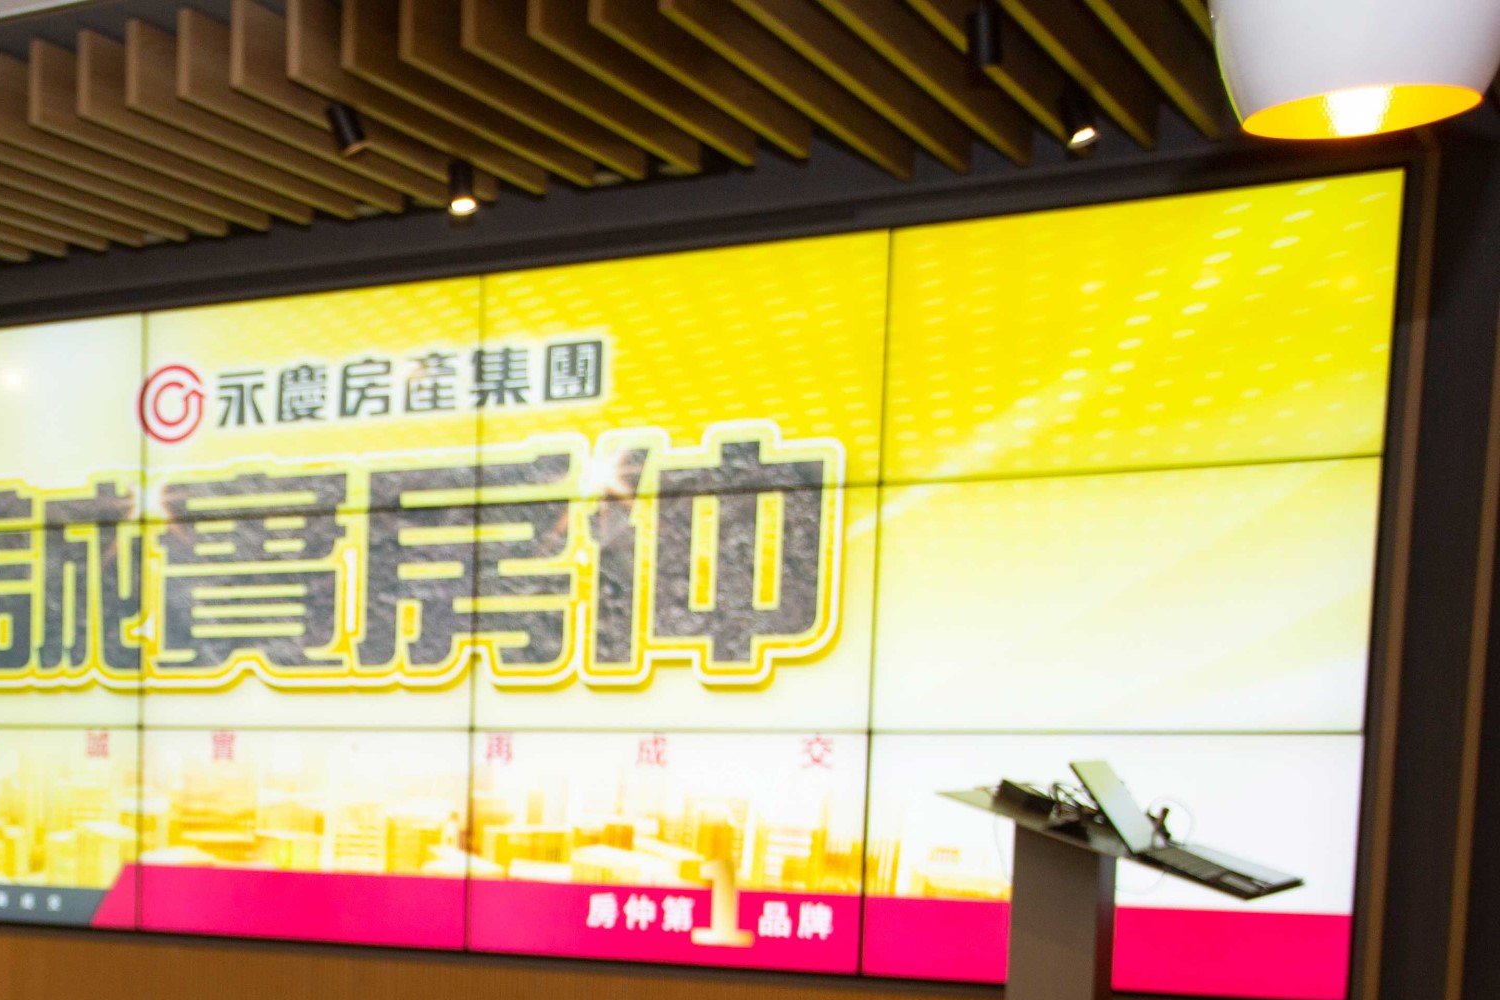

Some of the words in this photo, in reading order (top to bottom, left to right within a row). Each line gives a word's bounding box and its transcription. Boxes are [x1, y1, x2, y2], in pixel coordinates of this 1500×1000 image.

[215, 339, 603, 428] 永慶房產集團
